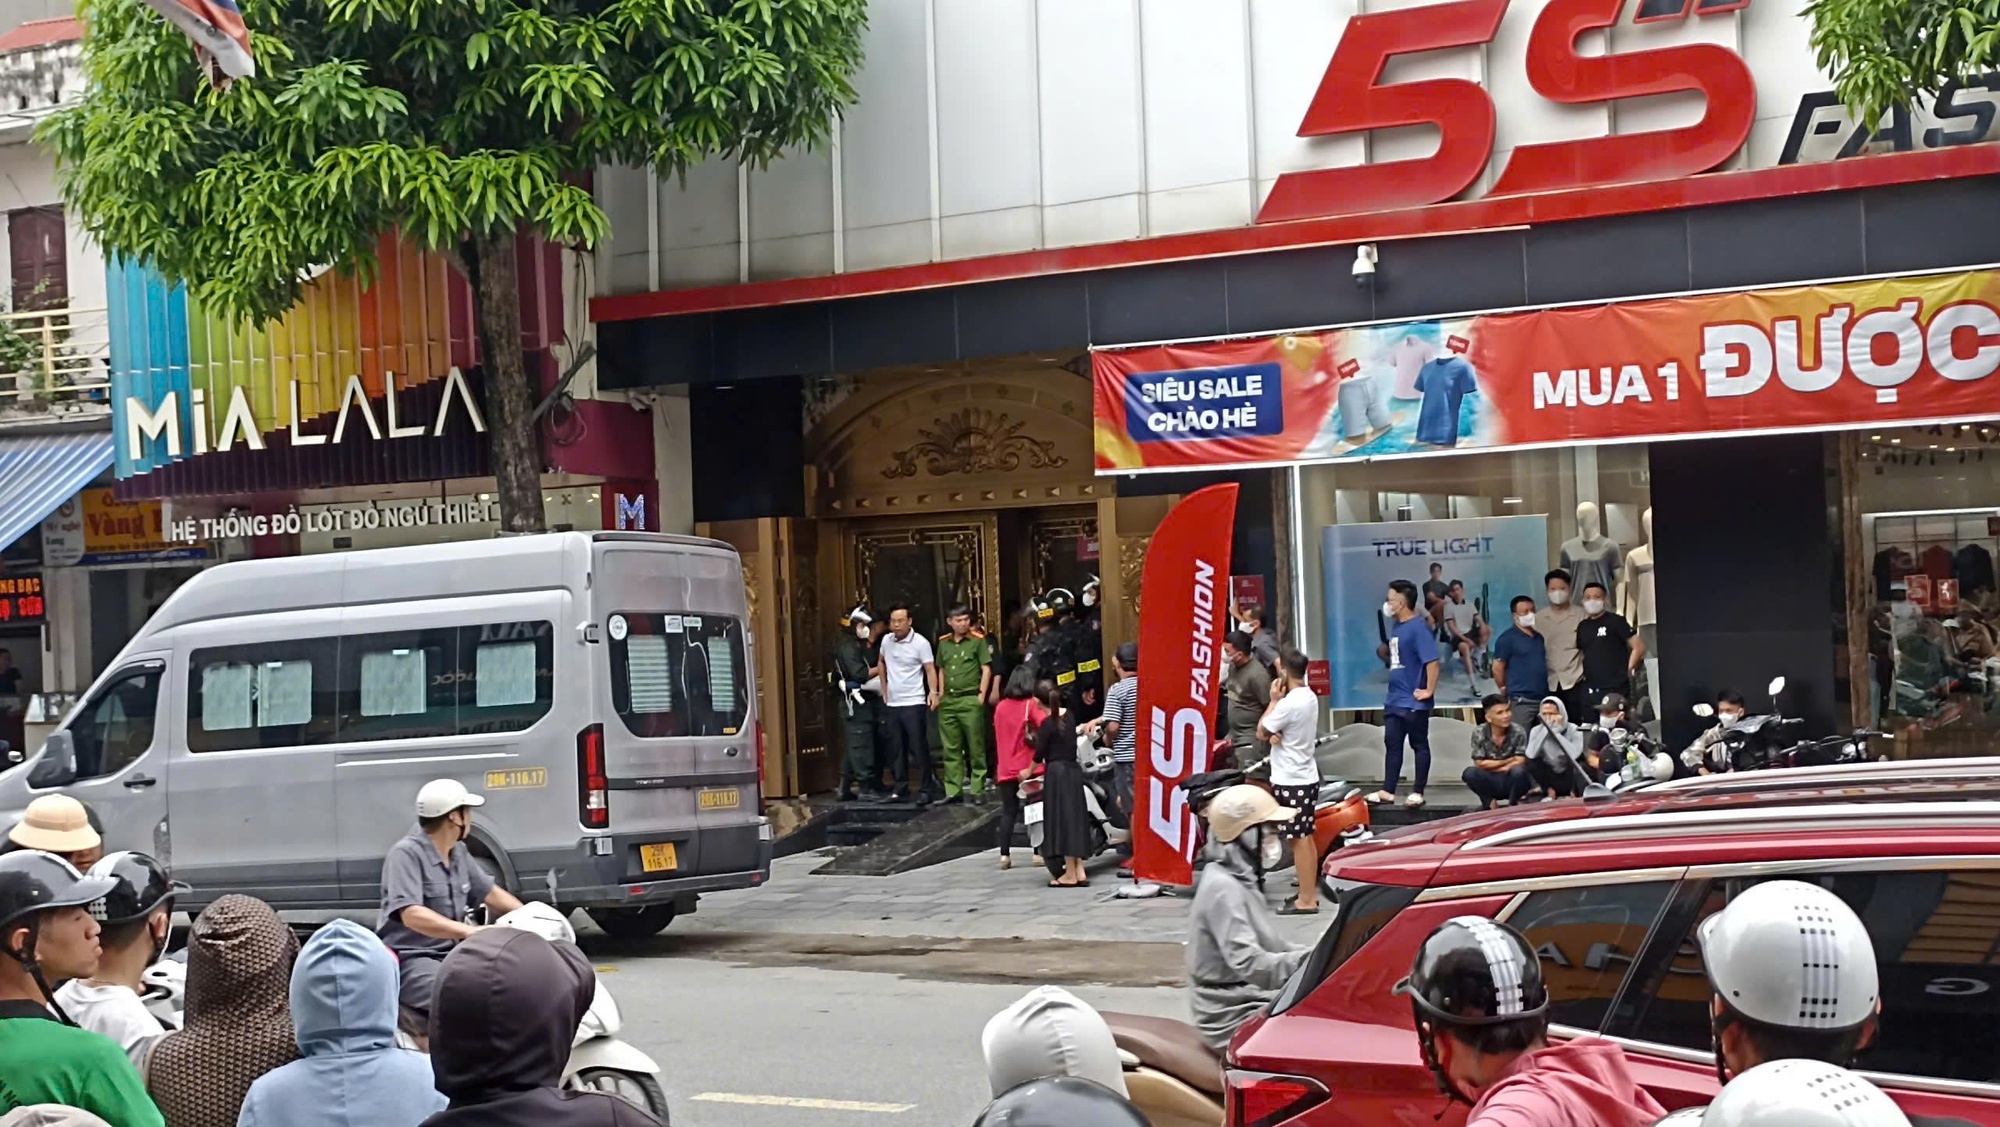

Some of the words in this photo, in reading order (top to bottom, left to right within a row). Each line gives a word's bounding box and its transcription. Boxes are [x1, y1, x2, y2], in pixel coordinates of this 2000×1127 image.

[1533, 364, 1652, 410] MUA
[1658, 362, 1679, 401] 1
[1700, 301, 2000, 404] ĐƯỢC
[290, 365, 488, 447] LALA
[1141, 377, 1195, 404] SIÊU
[1198, 375, 1263, 400] SALE
[1147, 405, 1220, 432] CHÀO
[1223, 401, 1257, 429] HÈ
[172, 515, 197, 545] HỆ
[200, 507, 268, 539] THỐNG
[271, 503, 300, 535] ĐỒ
[614, 493, 645, 530] M
[1372, 540, 1427, 557] TRUE
[1431, 536, 1494, 555] LIGHT
[1190, 558, 1215, 706] FASHION
